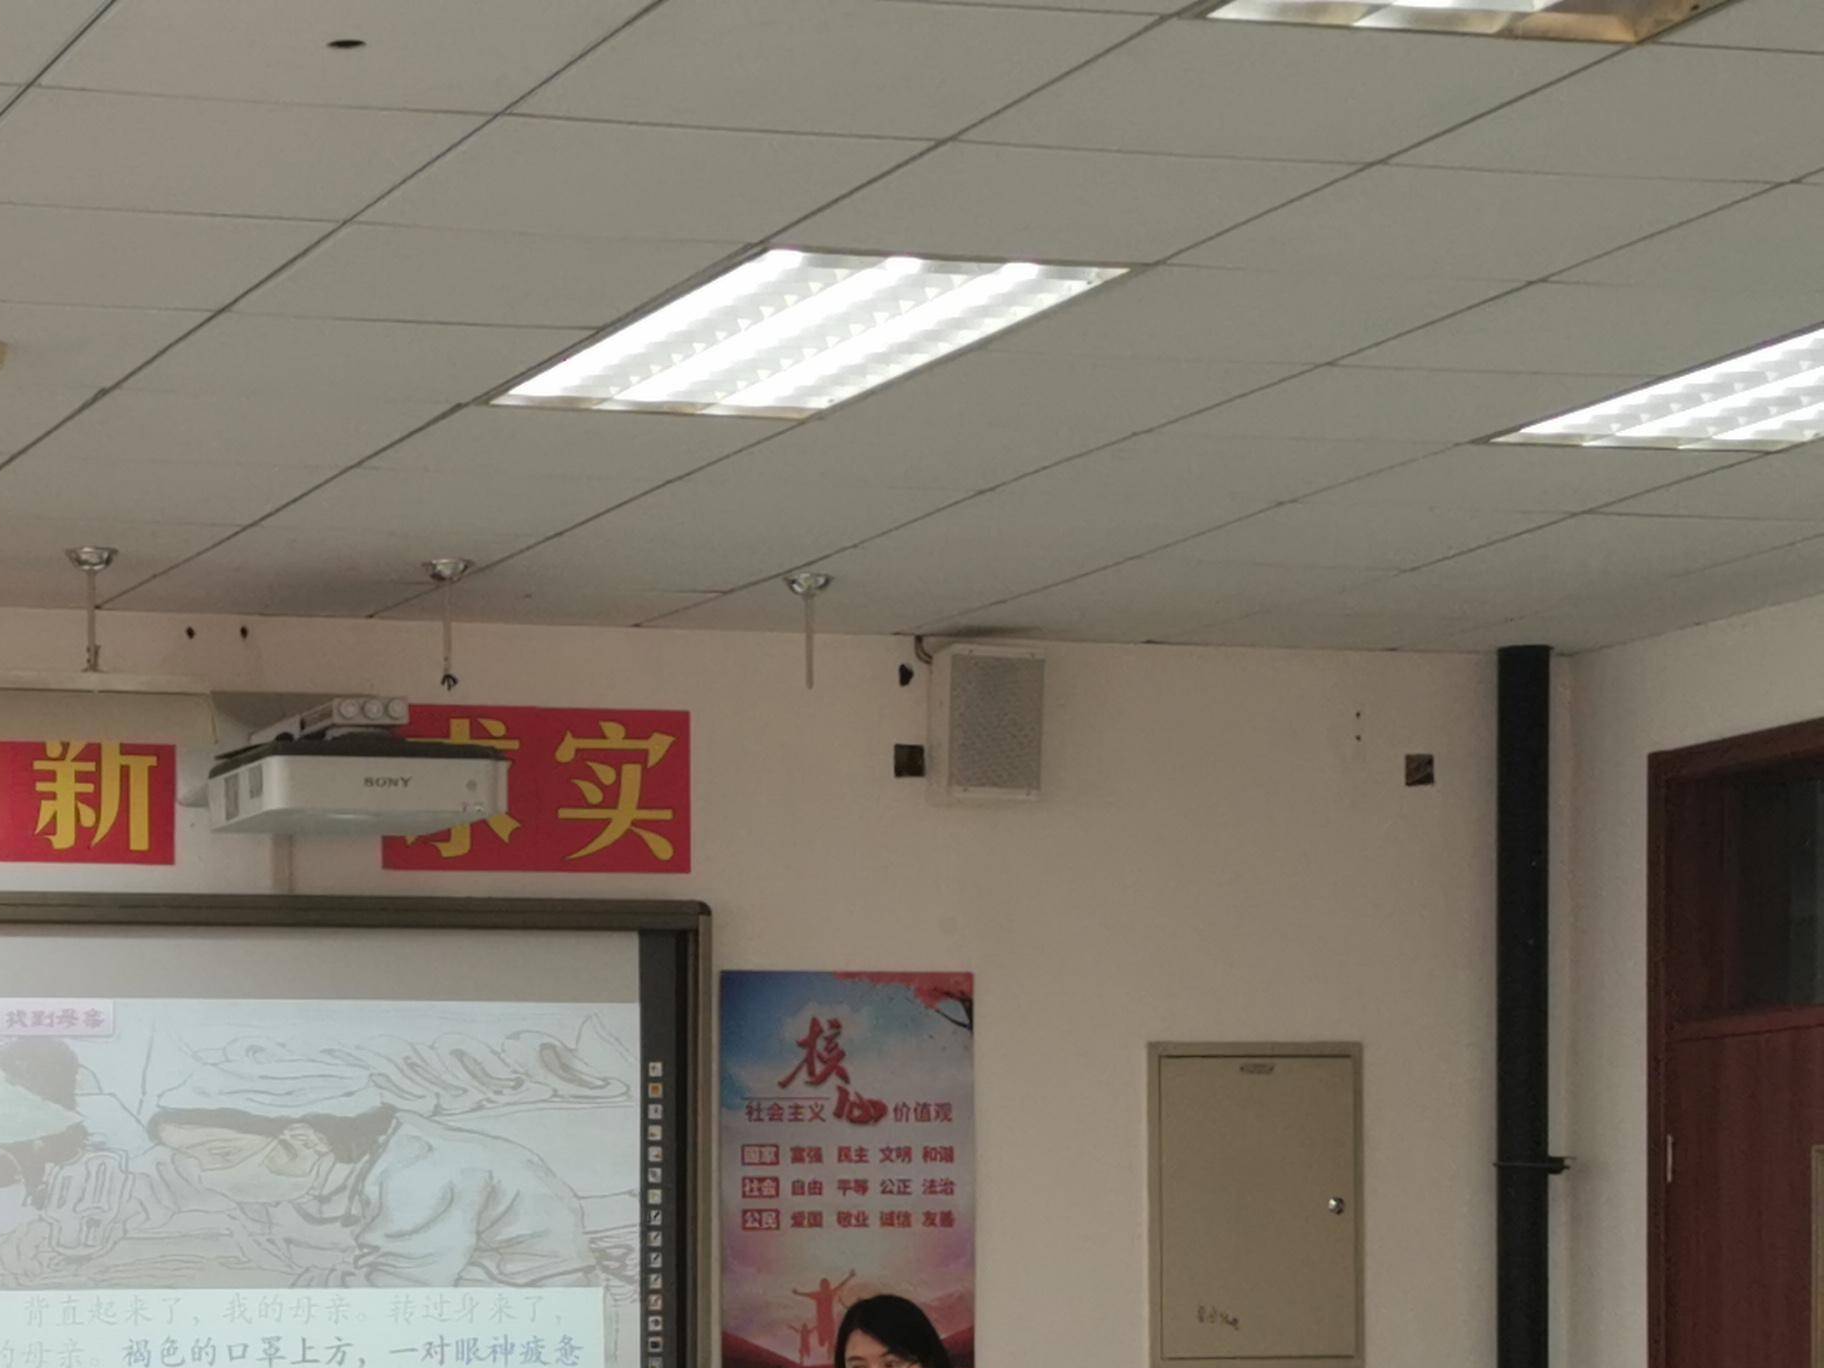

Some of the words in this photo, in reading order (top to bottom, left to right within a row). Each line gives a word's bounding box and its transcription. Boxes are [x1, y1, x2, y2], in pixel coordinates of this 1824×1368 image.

[363, 776, 413, 789] SONY
[745, 1102, 826, 1122] 社会主义
[893, 1102, 953, 1122] 价值观
[790, 1147, 823, 1164] 富强
[837, 1146, 870, 1164] 民主
[879, 1146, 913, 1164] 文明
[922, 1146, 955, 1164] 和谐
[744, 1178, 777, 1196] 社会
[791, 1178, 824, 1196] 自由
[837, 1178, 869, 1196] 平等
[880, 1178, 913, 1196] 公正
[922, 1178, 955, 1196] 法治
[744, 1211, 776, 1228] 公民
[790, 1210, 823, 1228] 爱国
[836, 1210, 870, 1228] 敬业
[879, 1210, 913, 1228] 诚信
[922, 1210, 955, 1228] 友善
